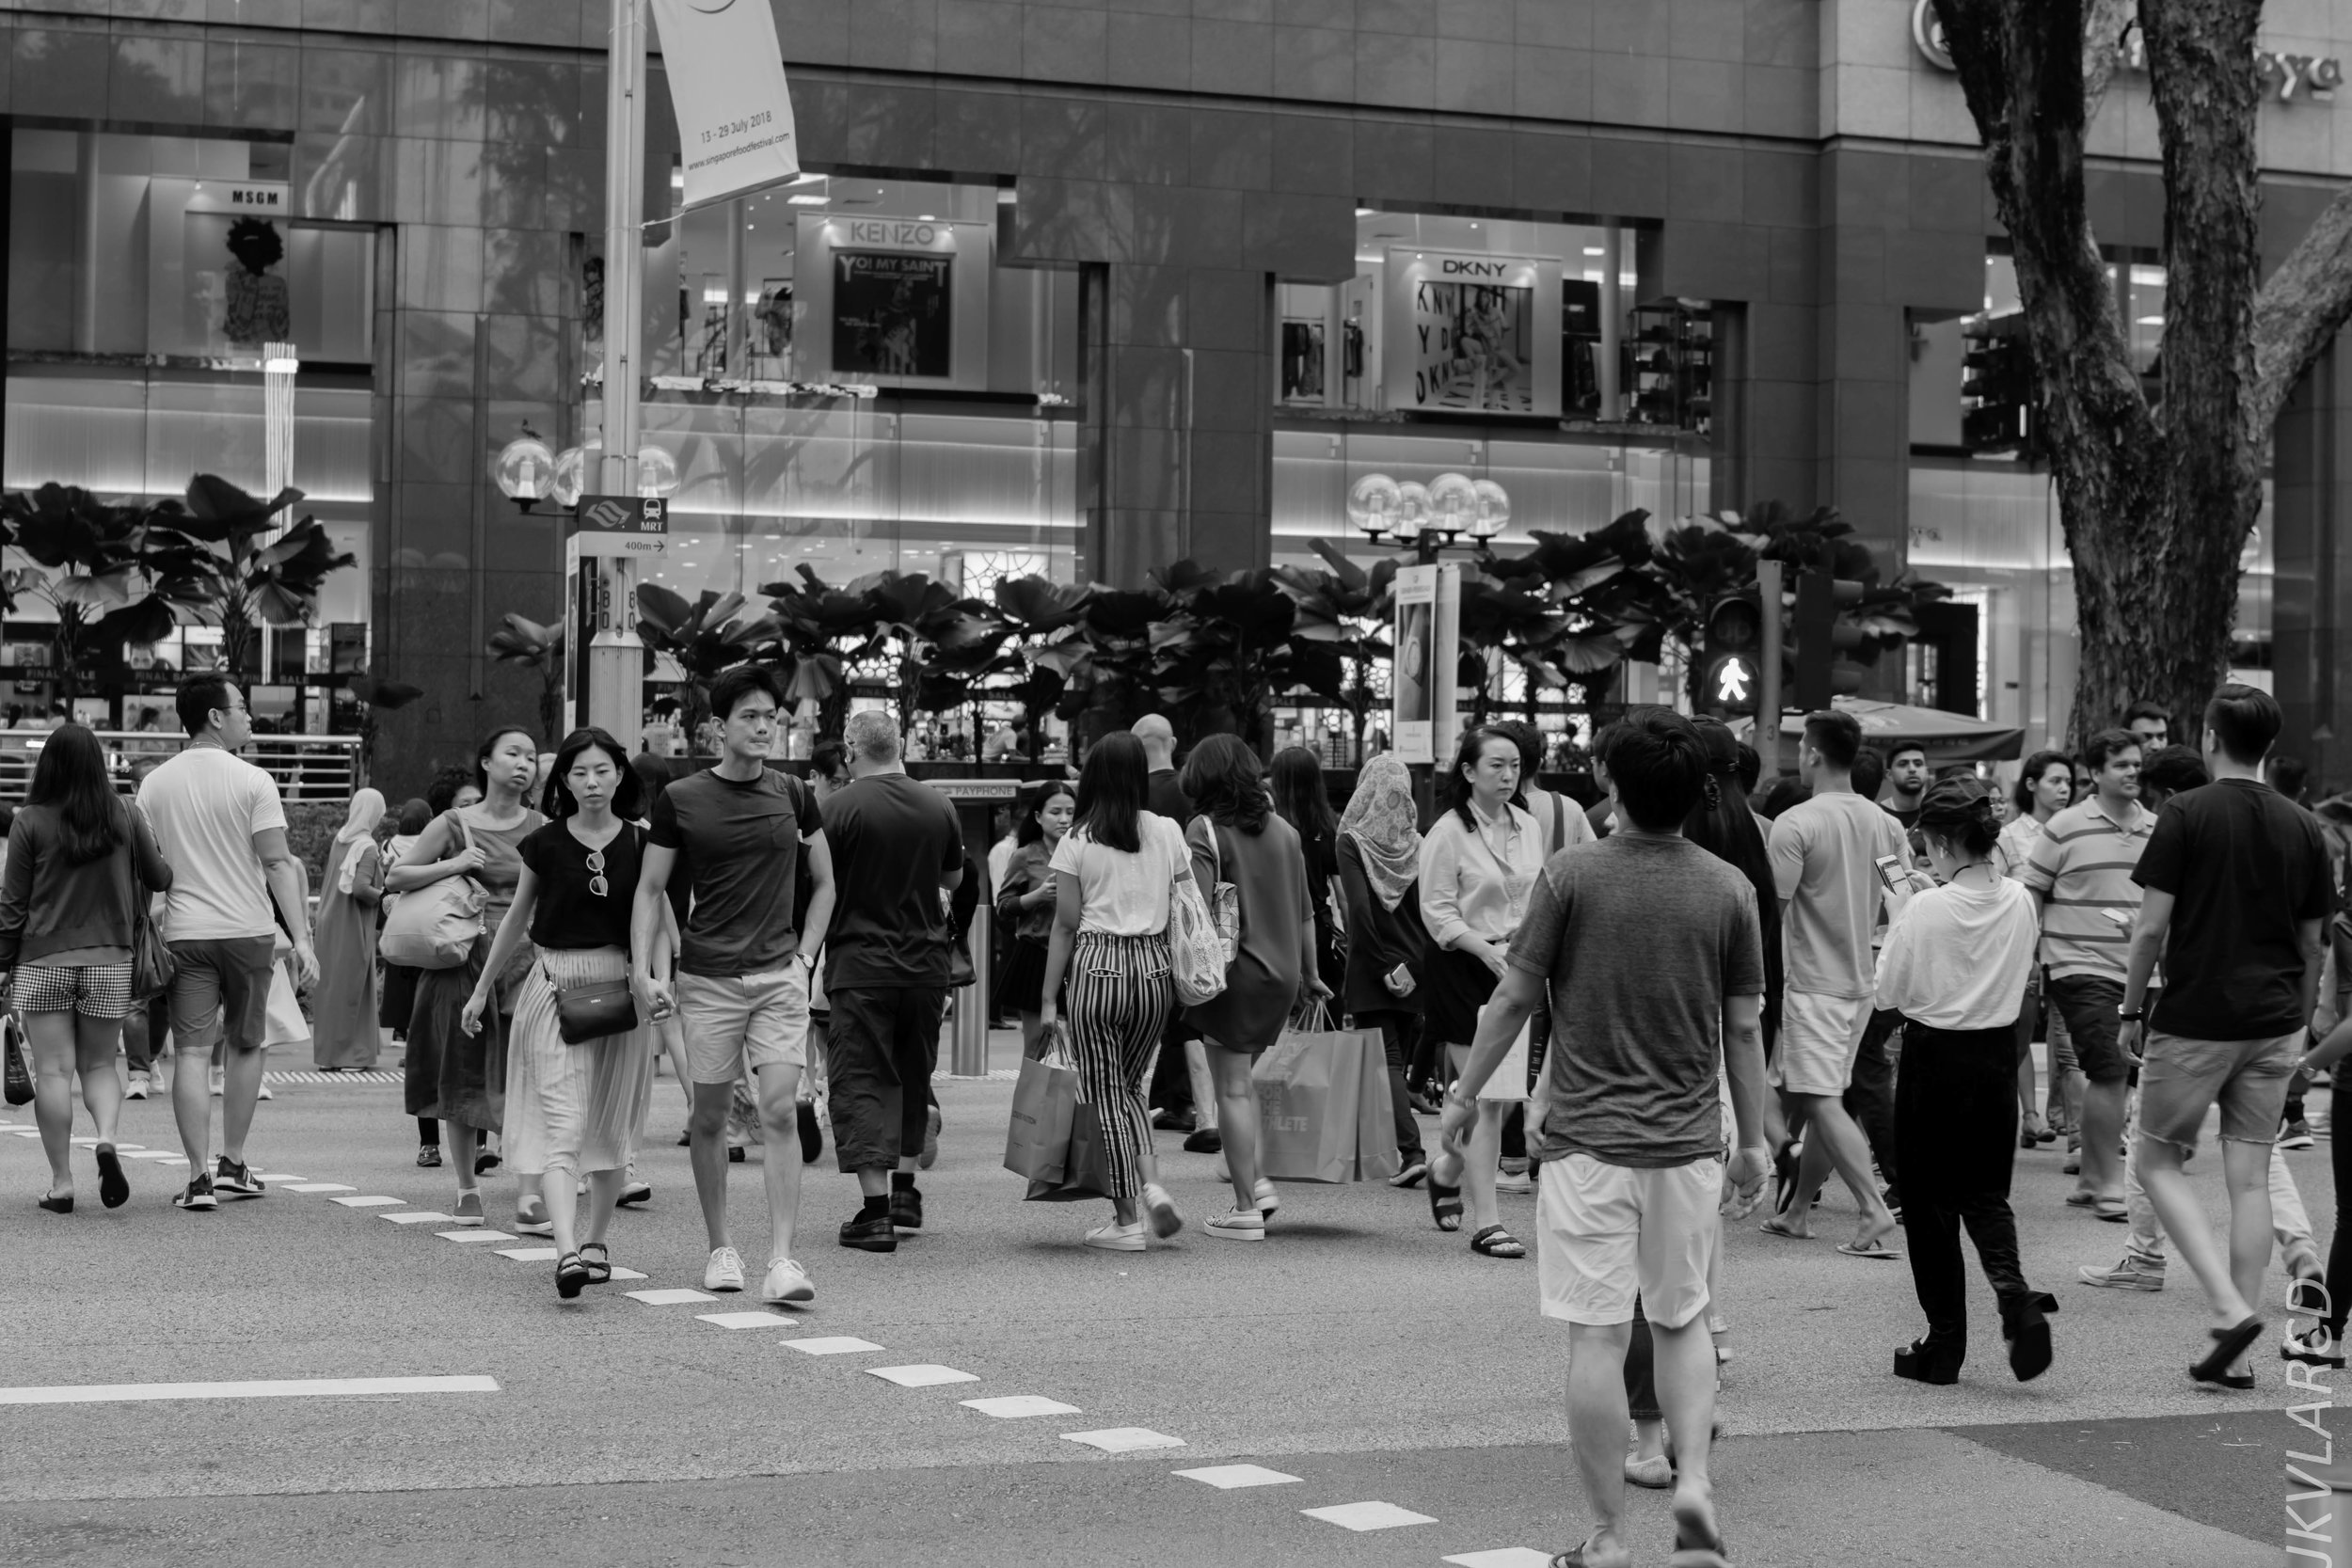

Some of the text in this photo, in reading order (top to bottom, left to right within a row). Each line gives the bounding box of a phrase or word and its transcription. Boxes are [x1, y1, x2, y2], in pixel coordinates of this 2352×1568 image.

[701, 130, 711, 144] 13
[718, 124, 729, 138] 29
[731, 119, 749, 134] July
[750, 110, 772, 128] 2018
[688, 132, 790, 170] www.singaporefoodfestival.com
[232, 190, 278, 205] MSGM
[850, 222, 935, 245] KENZO
[876, 258, 898, 271] MY
[901, 260, 947, 288] SAINT
[1442, 260, 1507, 277] DKNY
[640, 521, 663, 532] MRT
[624, 542, 652, 551] 400m
[26, 669, 60, 680] FINAL
[279, 674, 310, 686] SALE
[955, 785, 1014, 797] PAYPHONE
